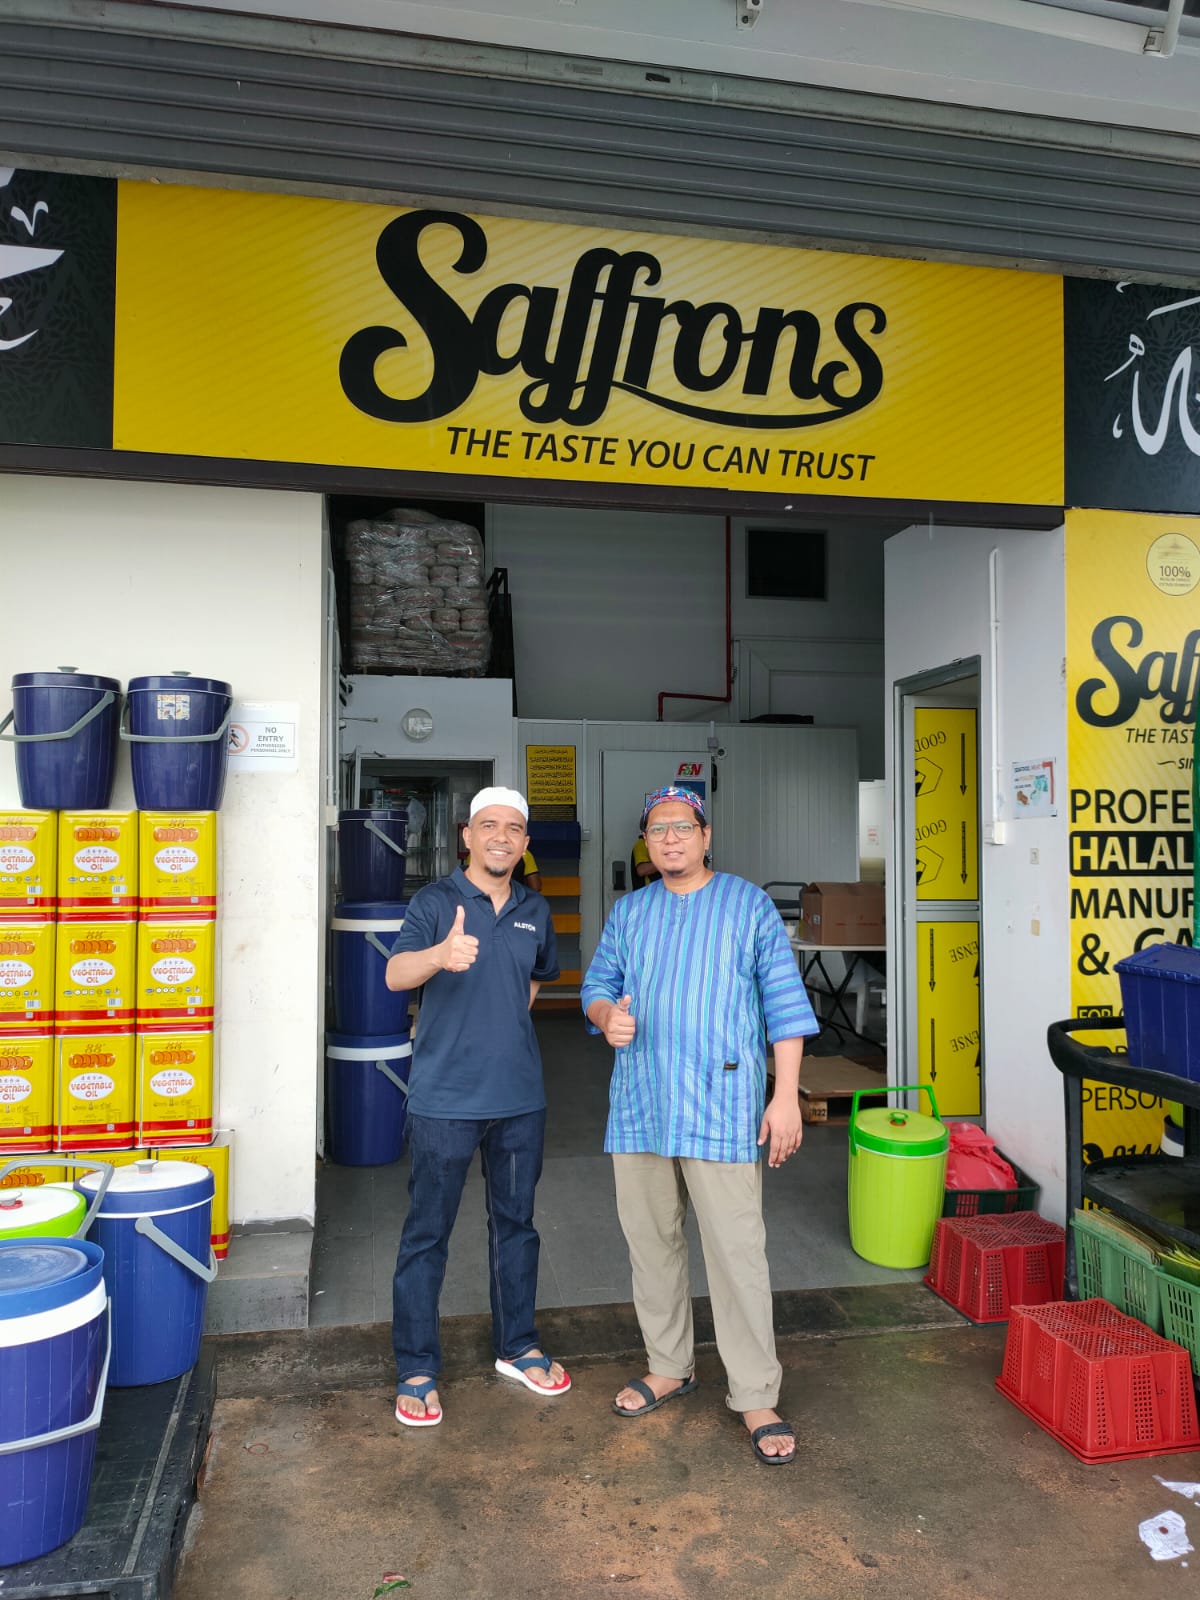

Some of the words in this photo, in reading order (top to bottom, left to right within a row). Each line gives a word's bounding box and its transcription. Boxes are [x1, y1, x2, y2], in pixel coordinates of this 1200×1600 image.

[339, 209, 887, 429] Saffrons
[448, 427, 512, 458] THE
[521, 432, 618, 465] TASTE
[627, 439, 694, 470] YOU
[703, 445, 769, 475] CAN
[778, 450, 875, 481] TRUST
[1160, 565, 1191, 577] 100%
[265, 726, 277, 734] NO
[1126, 728, 1157, 744] THE
[1070, 789, 1191, 824] PROFE
[1072, 836, 1194, 870] HALAL
[0, 855, 34, 863] GETABLE
[76, 855, 117, 864] VEGETABLE
[156, 856, 196, 864] VEGETABLE
[6, 863, 19, 871] OIL
[90, 863, 103, 871] OIL
[170, 863, 183, 871] OIL
[1078, 933, 1110, 976] &
[0, 969, 32, 978] GETABLE
[72, 968, 113, 977] VEGETABLE
[153, 967, 193, 975] VEGETABLE
[4, 977, 17, 985] OIL
[86, 976, 99, 984] OIL
[167, 974, 180, 982] OIL
[71, 1081, 113, 1091] VEGETABLE
[152, 1078, 193, 1087] VEGETABLE
[0, 1084, 30, 1093] GETABLE
[166, 1086, 179, 1094] OIL
[2, 1093, 15, 1101] OIL
[85, 1090, 98, 1098] OIL
